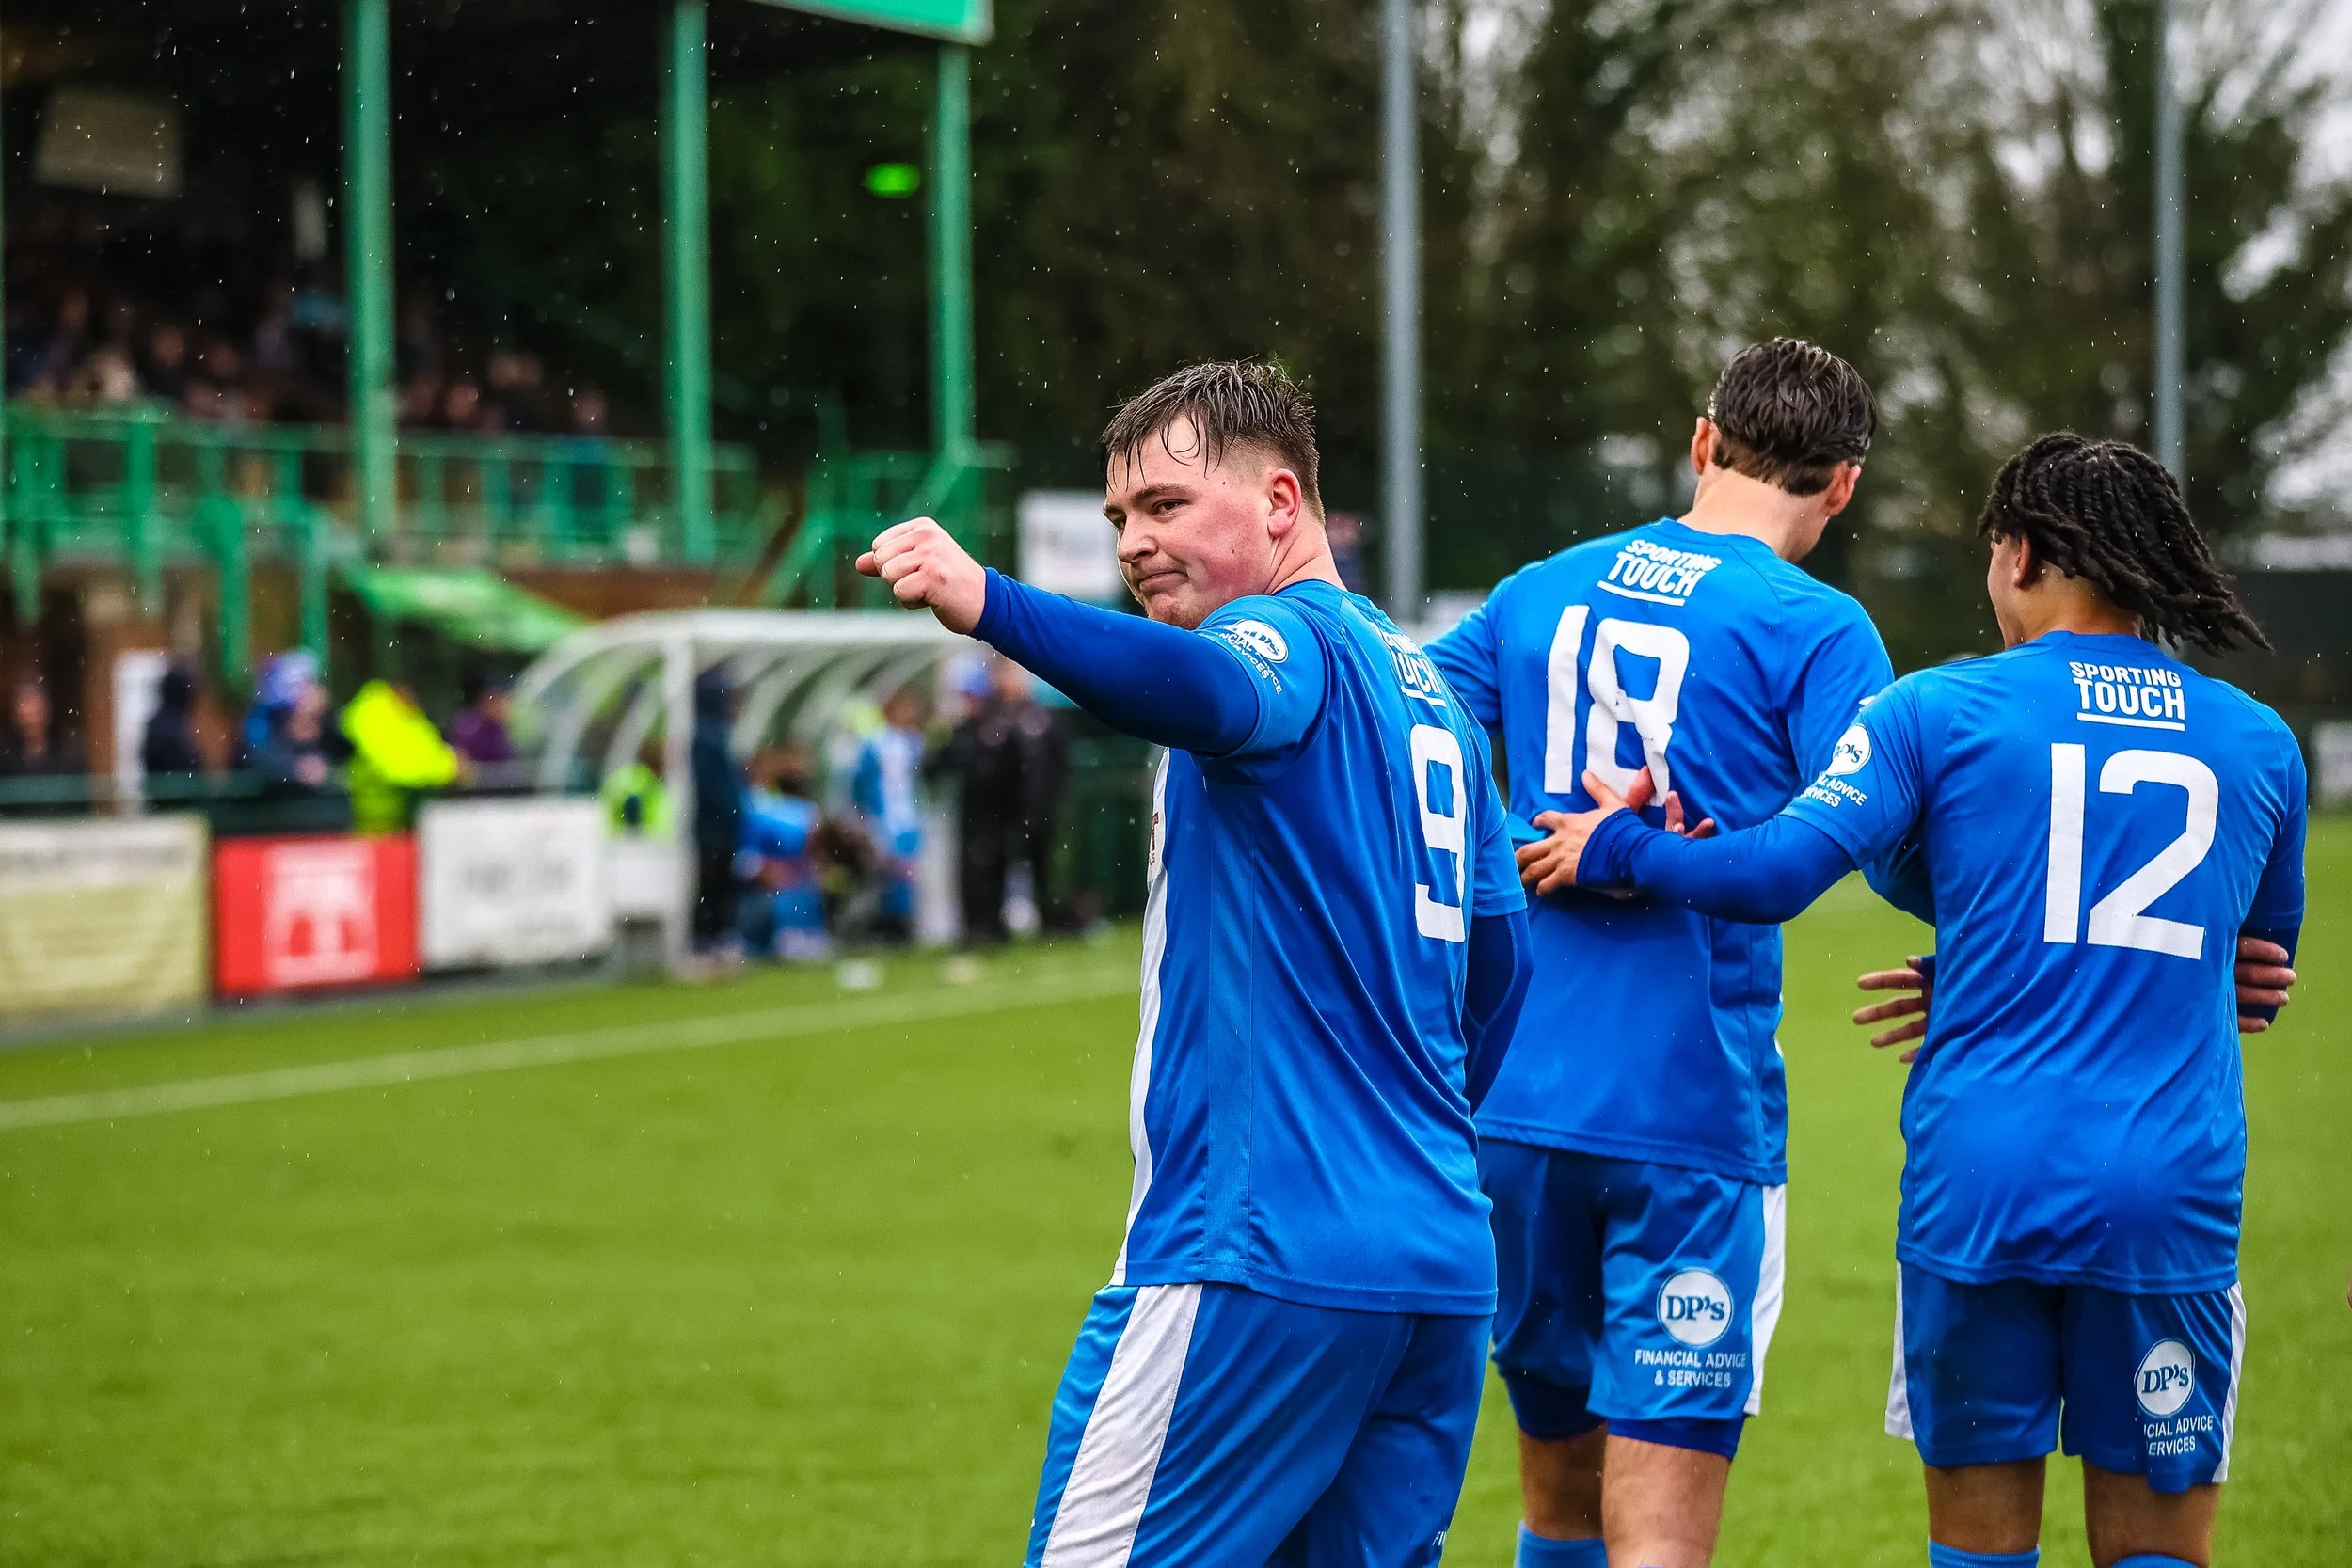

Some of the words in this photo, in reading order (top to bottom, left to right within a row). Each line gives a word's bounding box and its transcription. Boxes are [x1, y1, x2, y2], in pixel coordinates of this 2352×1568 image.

[1625, 539, 1722, 572] SPORTING
[1607, 551, 1706, 597] TOUCH
[2069, 661, 2182, 688] SPORTING
[1544, 604, 1690, 807] 18
[2073, 676, 2185, 721] TOUCH
[1826, 777, 1867, 807] ADVICE
[1410, 722, 1467, 943] 9
[2043, 742, 2218, 960] 12
[1664, 1295, 1725, 1322] DP's
[1634, 1348, 1702, 1369] FINANCIAL
[1705, 1352, 1747, 1369] ADVICE
[1654, 1370, 1664, 1386] &
[1667, 1370, 1731, 1389] SERVICES
[2141, 1364, 2190, 1394] DP's
[2175, 1414, 2214, 1435] ADVICE
[2146, 1435, 2196, 1457] ERVICES
